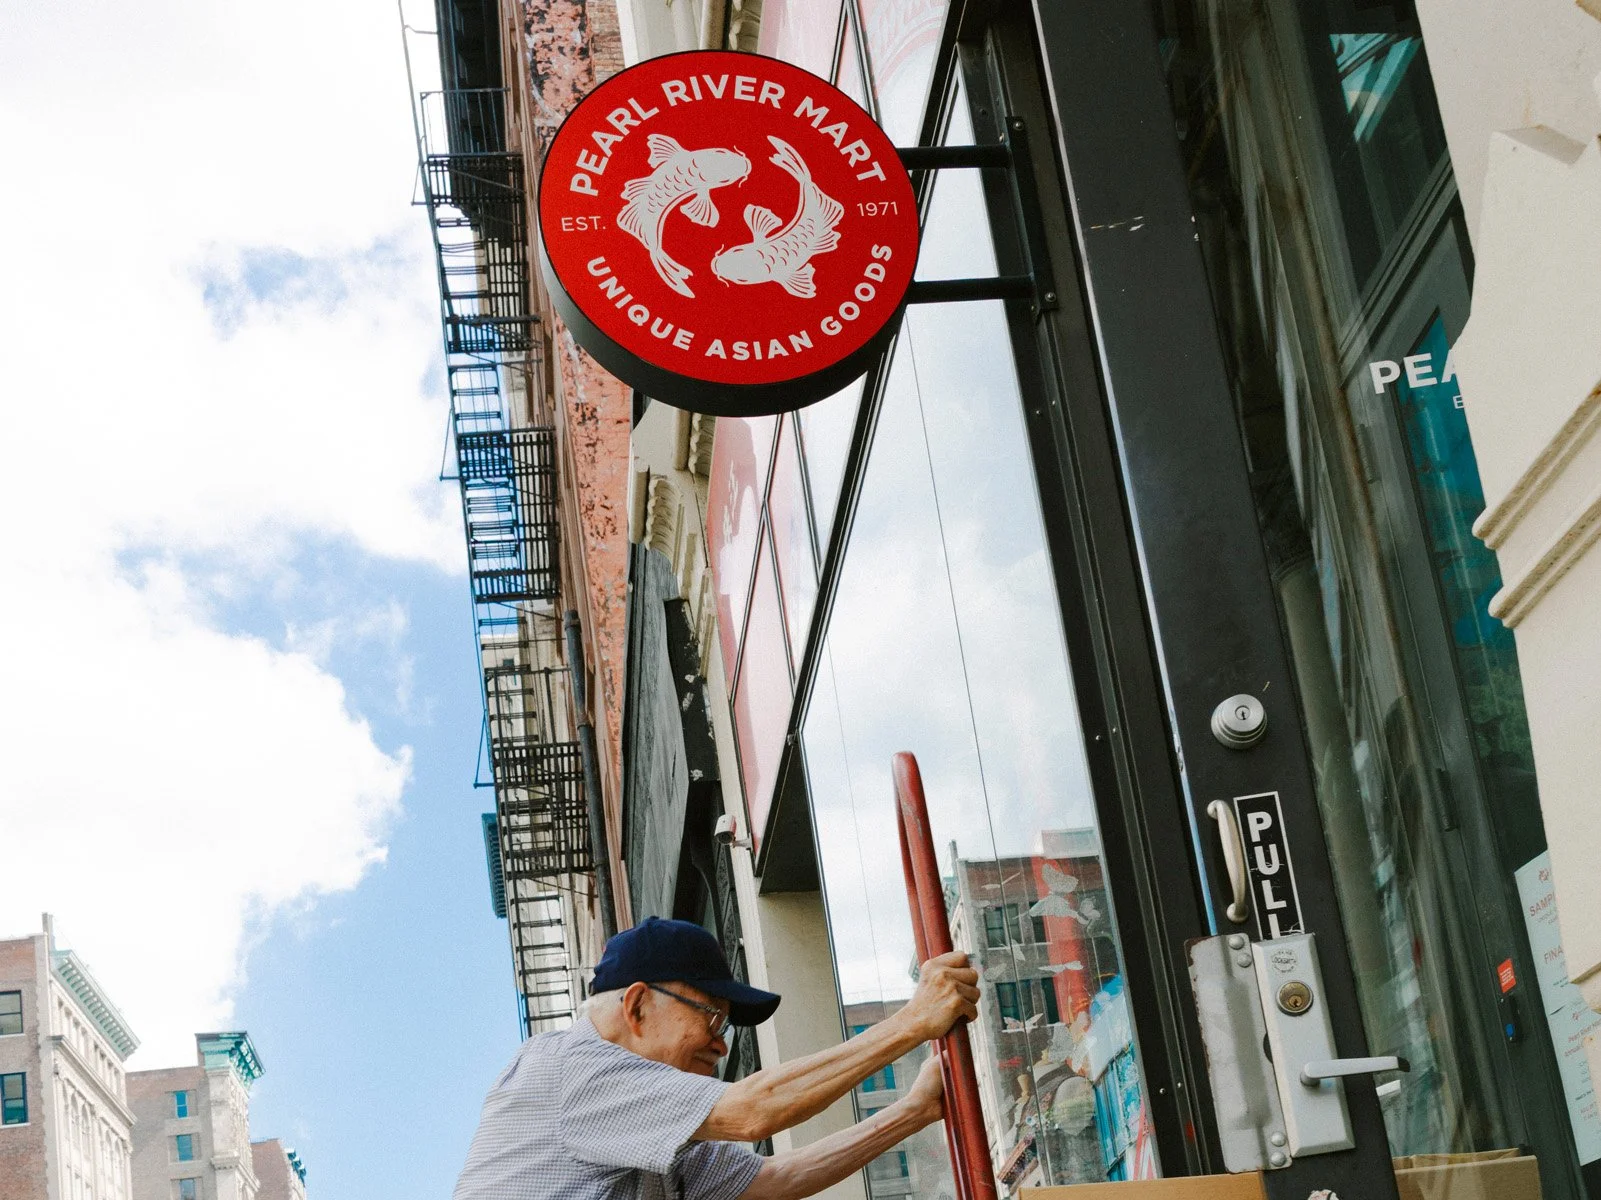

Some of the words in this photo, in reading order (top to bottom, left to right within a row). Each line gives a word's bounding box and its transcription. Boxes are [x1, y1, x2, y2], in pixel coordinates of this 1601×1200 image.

[569, 97, 660, 197] PEARL
[661, 74, 786, 109] RIVER
[793, 96, 886, 184] MART
[561, 215, 607, 232] EST.
[857, 201, 899, 217] 1971
[587, 256, 696, 351] UNIQUE
[704, 330, 814, 361] ASIAN
[820, 243, 893, 337] GOODS
